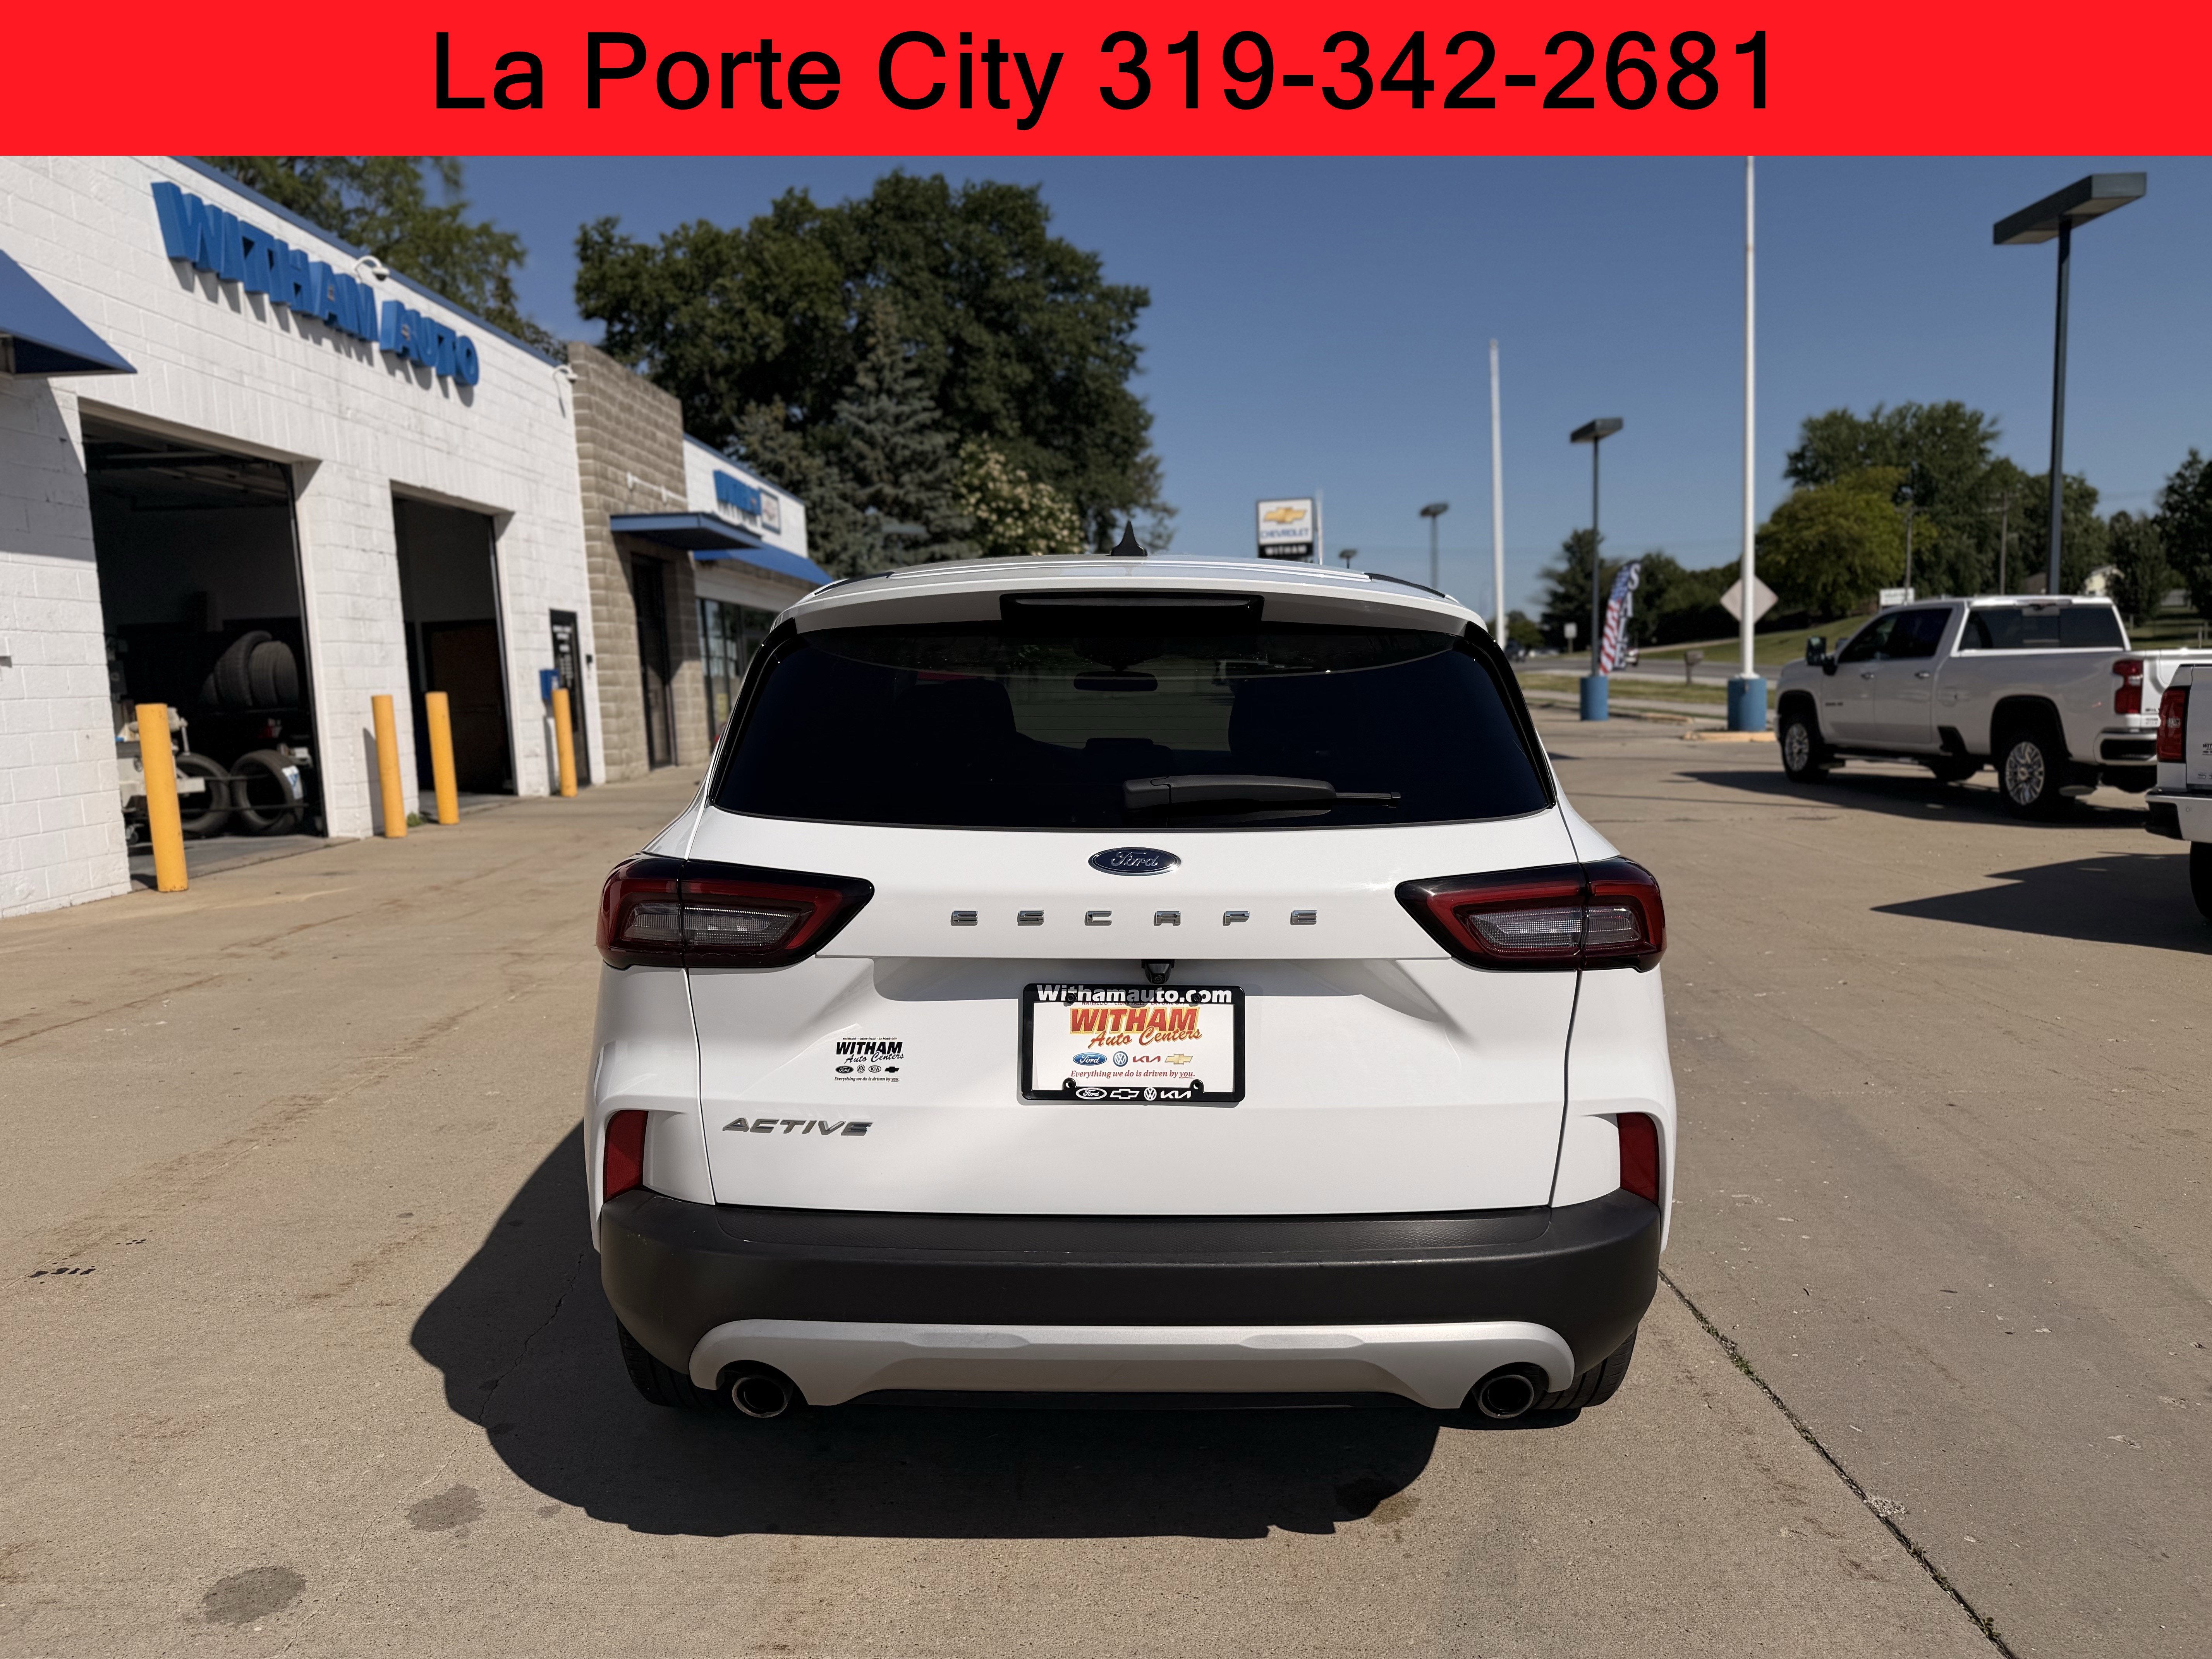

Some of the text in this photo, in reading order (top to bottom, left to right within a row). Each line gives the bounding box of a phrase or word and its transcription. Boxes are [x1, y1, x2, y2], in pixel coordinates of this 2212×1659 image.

[151, 182, 479, 386] WITHAM AUTO
[951, 910, 1317, 926] ESCAPE
[1070, 1008, 1199, 1033] WITHAM
[1088, 1025, 1202, 1049] Auto Centers
[836, 1041, 903, 1054] WITHAM
[844, 1052, 904, 1063] Auto Centers
[1071, 1070, 1111, 1079] Everything
[1170, 1070, 1178, 1079] by
[723, 1118, 874, 1136] ACTIVE
